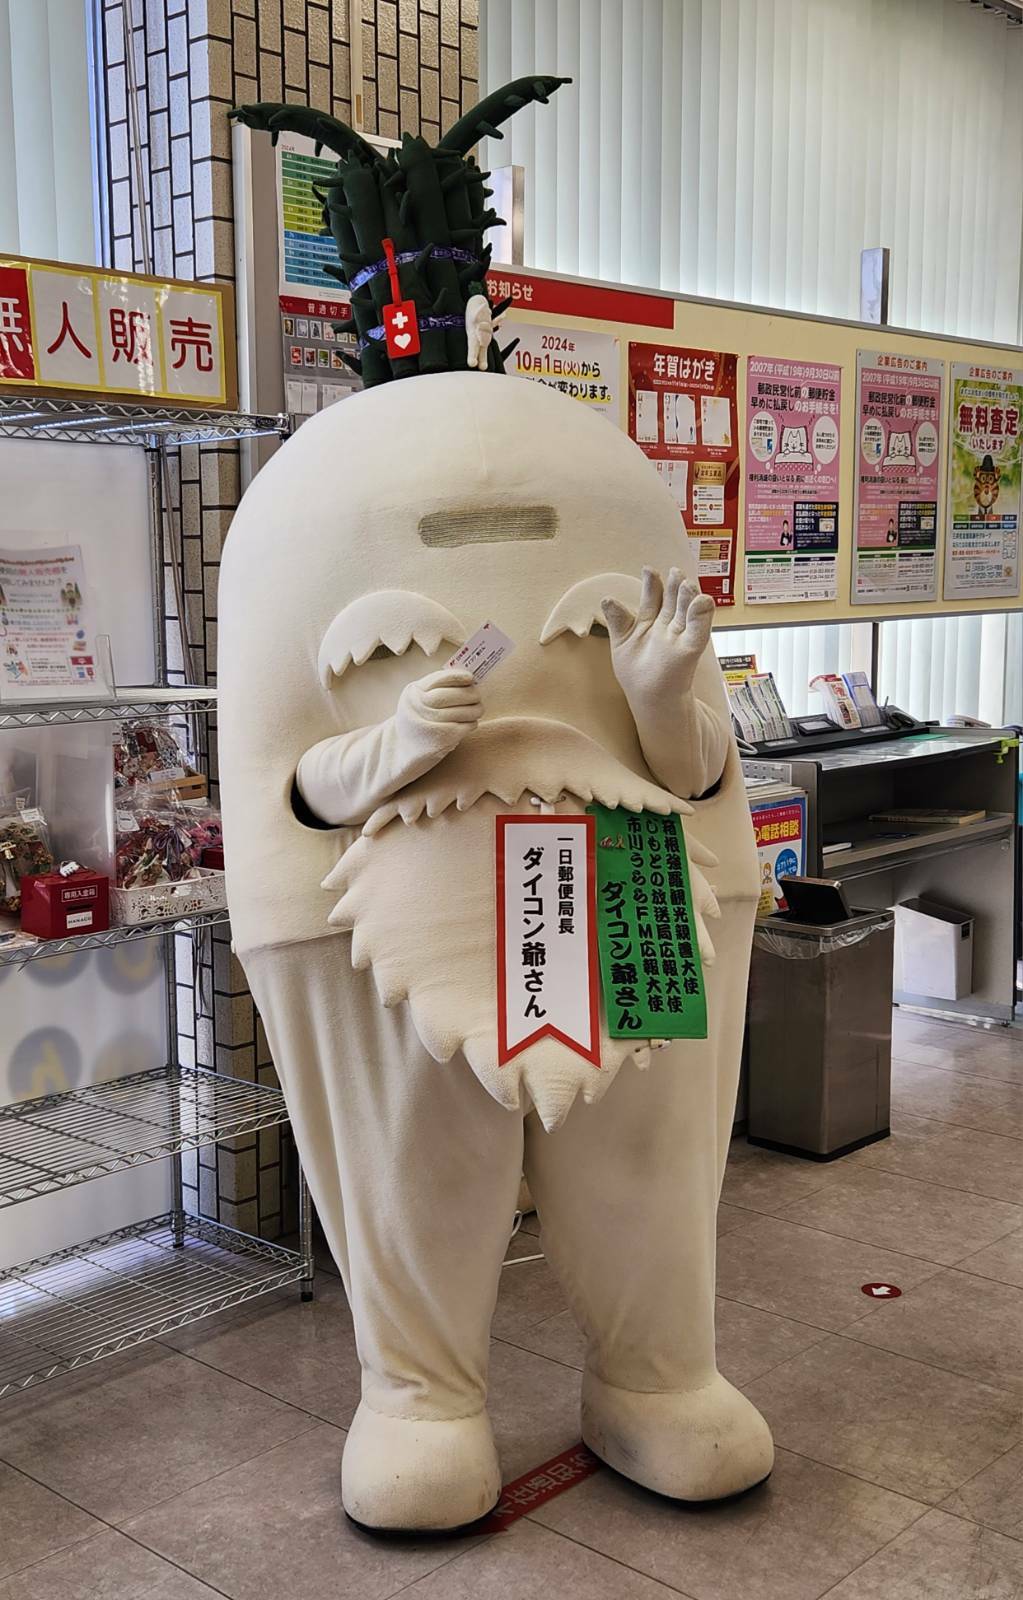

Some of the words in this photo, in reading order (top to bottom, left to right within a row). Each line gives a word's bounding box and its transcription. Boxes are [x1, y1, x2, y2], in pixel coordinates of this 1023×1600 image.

[487, 280, 534, 302] お知らせ
[308, 302, 348, 317] 普通切手
[541, 335, 575, 352] 2024年
[515, 351, 601, 378] 10月1日(火)から
[653, 354, 715, 381] 年賀はがき
[877, 355, 928, 371] 企業広告のご案内
[969, 367, 1013, 382] 企業広告のご案内
[757, 382, 836, 401] 郵政民営化前の郵便貯金
[868, 391, 936, 408] 郵政民営化前の郵便貯金
[959, 404, 1019, 435] 無料査定
[972, 439, 1004, 450] いたします
[557, 837, 575, 935] 一日郵便局長
[627, 816, 664, 1013] 市川うららFM広報大使
[521, 846, 547, 1018] ダイコン爺さん
[601, 881, 643, 1030] ダイコン爺さん
